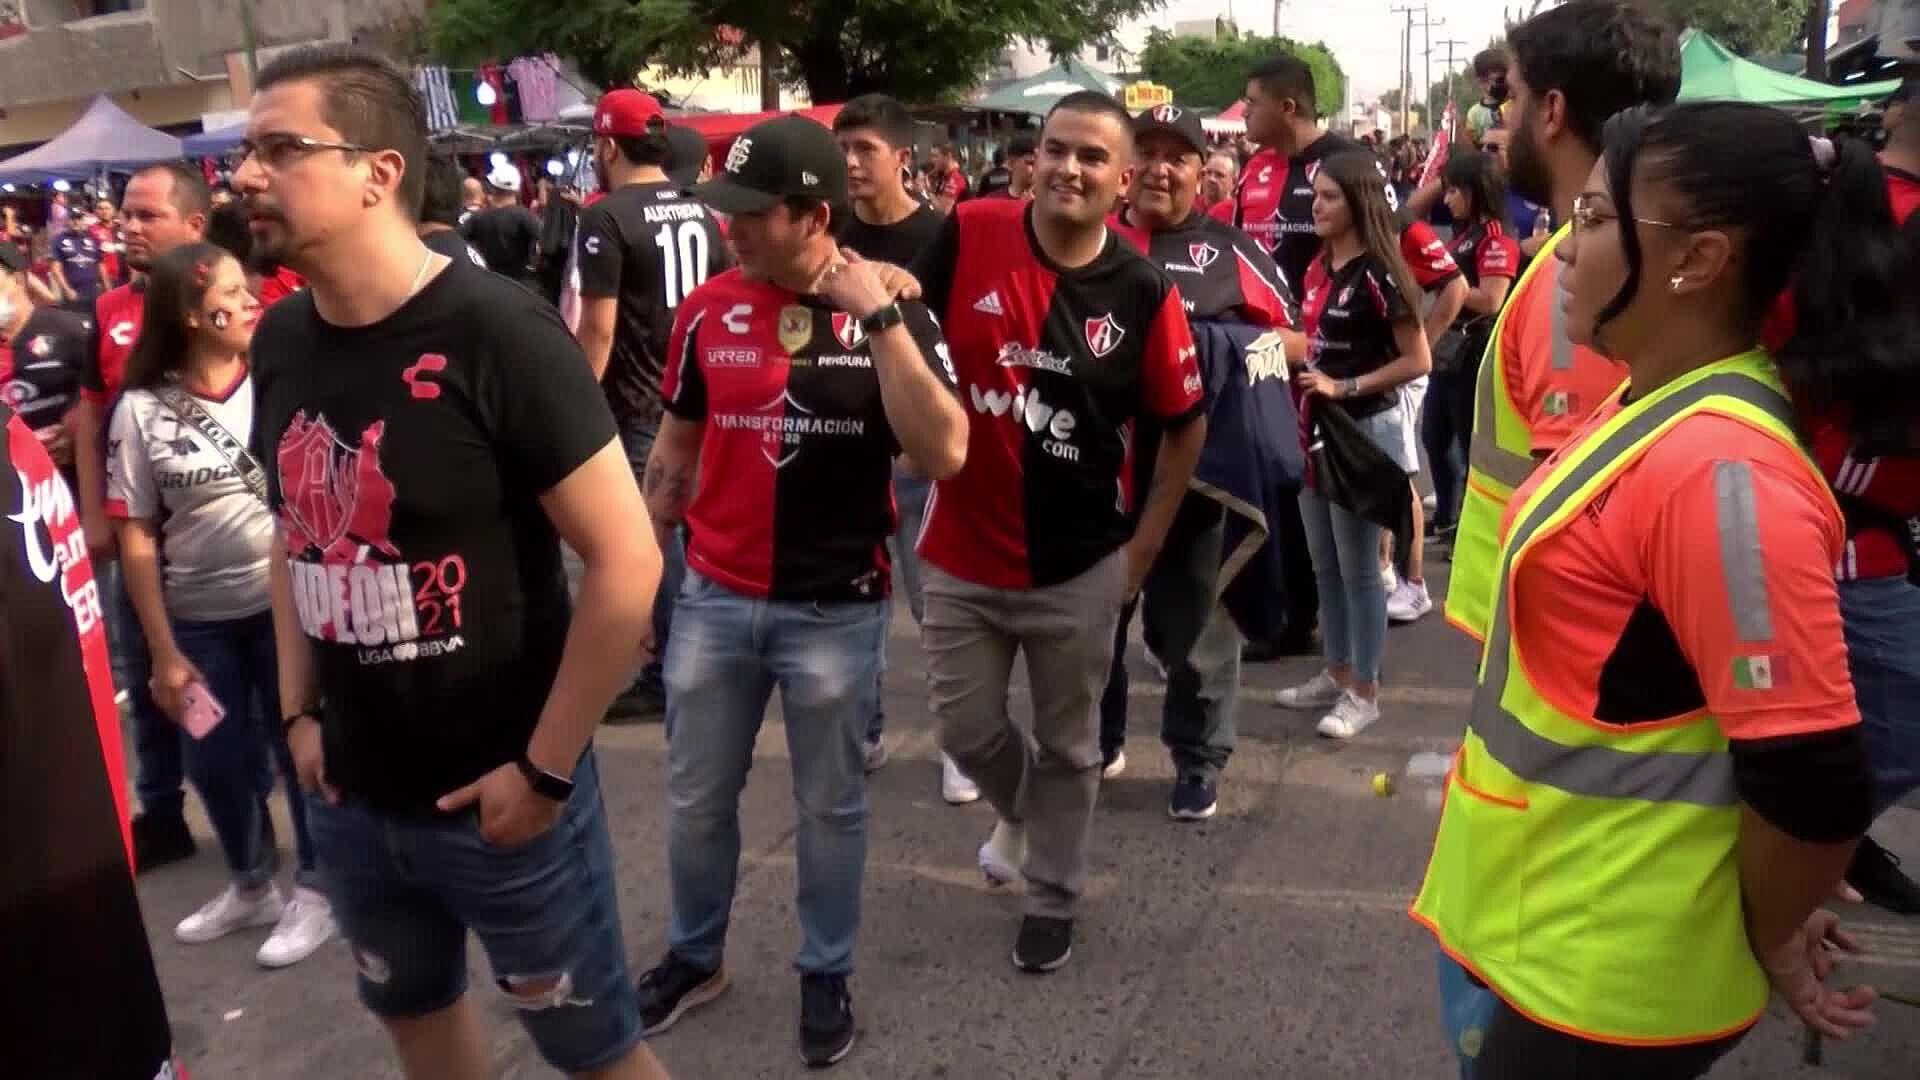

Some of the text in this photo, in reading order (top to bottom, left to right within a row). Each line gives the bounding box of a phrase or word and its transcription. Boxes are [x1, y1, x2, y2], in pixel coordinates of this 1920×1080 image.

[655, 221, 708, 308] 10
[1042, 438, 1079, 462] com
[412, 554, 466, 600] 20
[417, 594, 462, 636] 21
[420, 635, 465, 657] BBVA
